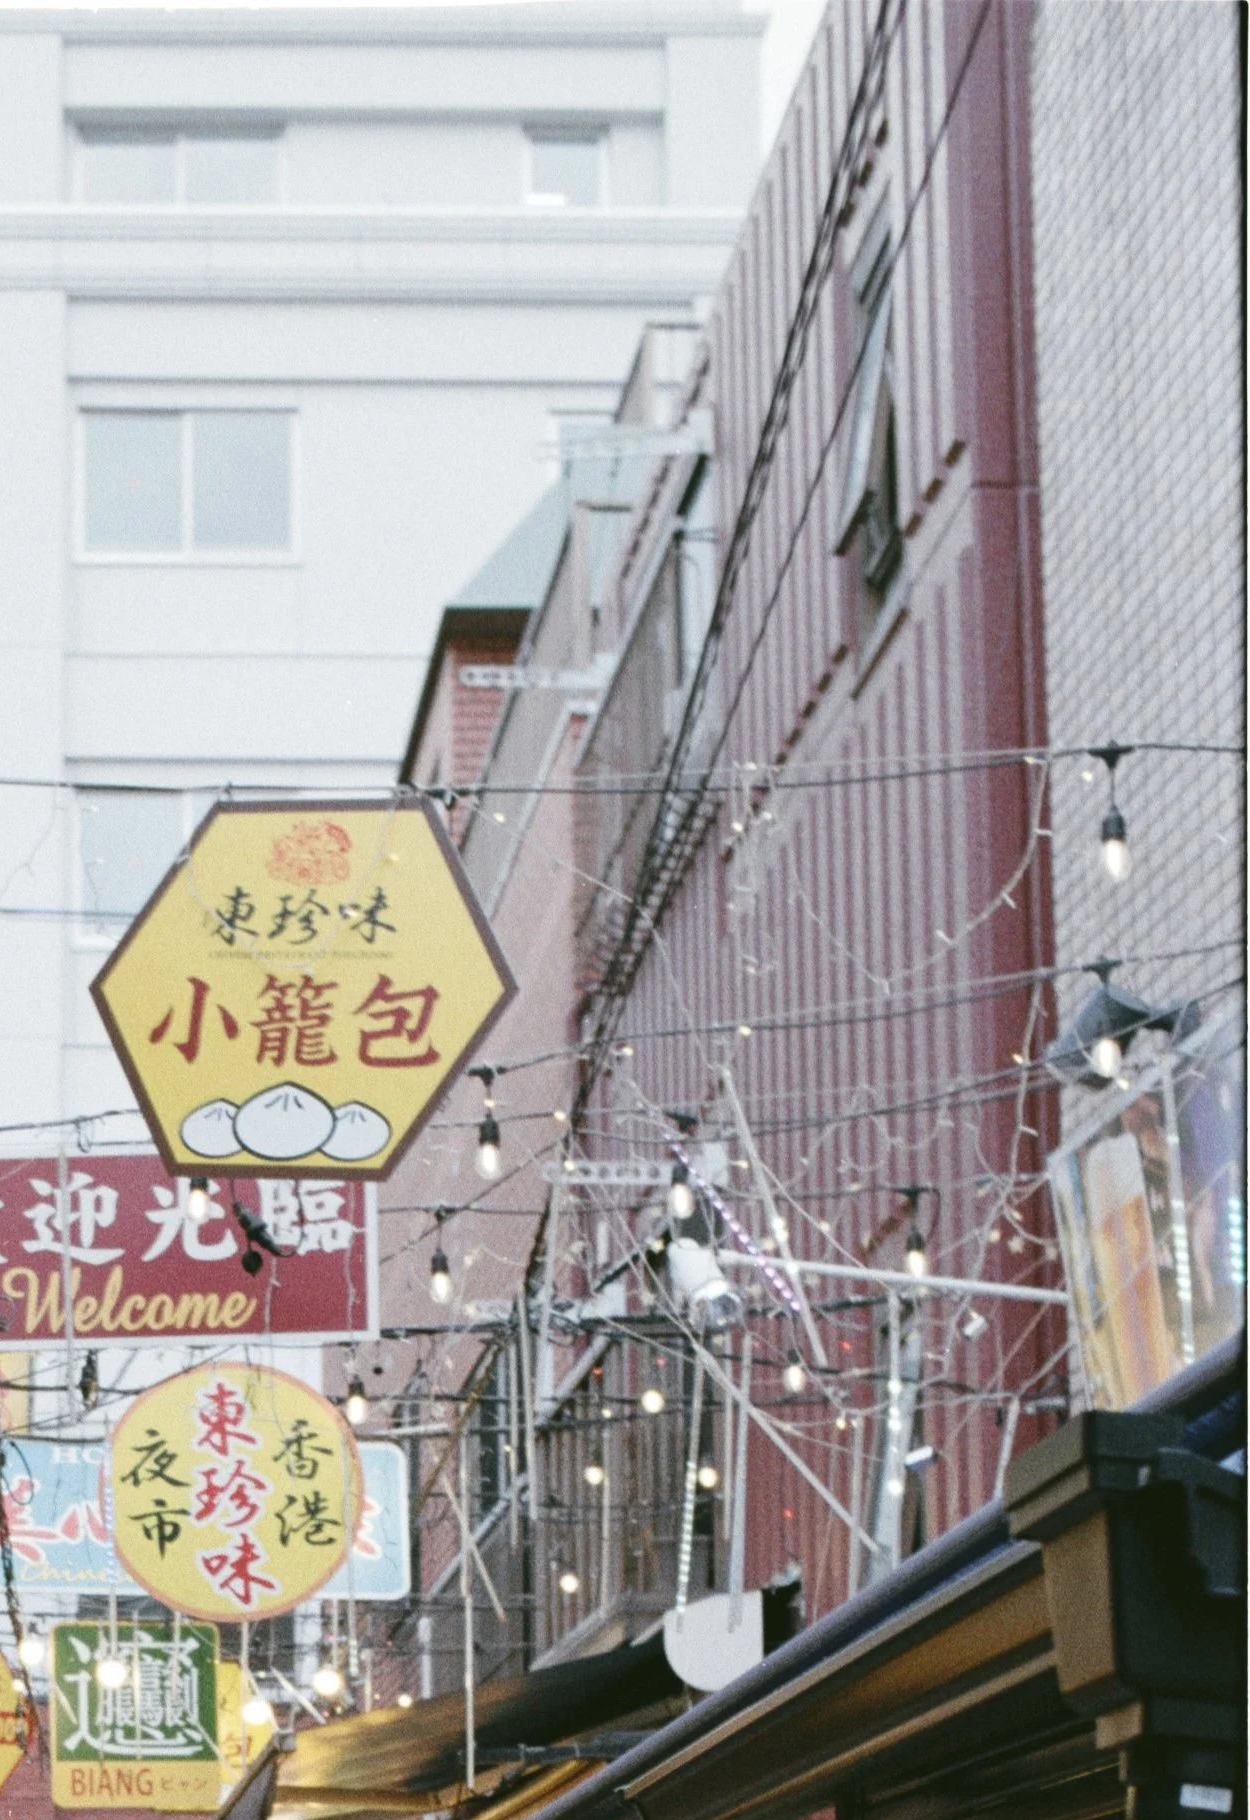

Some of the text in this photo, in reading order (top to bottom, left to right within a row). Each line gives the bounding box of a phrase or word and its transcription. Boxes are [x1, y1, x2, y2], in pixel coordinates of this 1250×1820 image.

[214, 886, 398, 946] 東珍味
[149, 974, 443, 1068] 小籠包
[2, 1266, 257, 1334] Welcome
[120, 1428, 192, 1560] 夜市
[191, 1381, 278, 1604] 東珍味
[272, 1420, 344, 1548] 香港
[70, 1768, 153, 1797] BIANG
